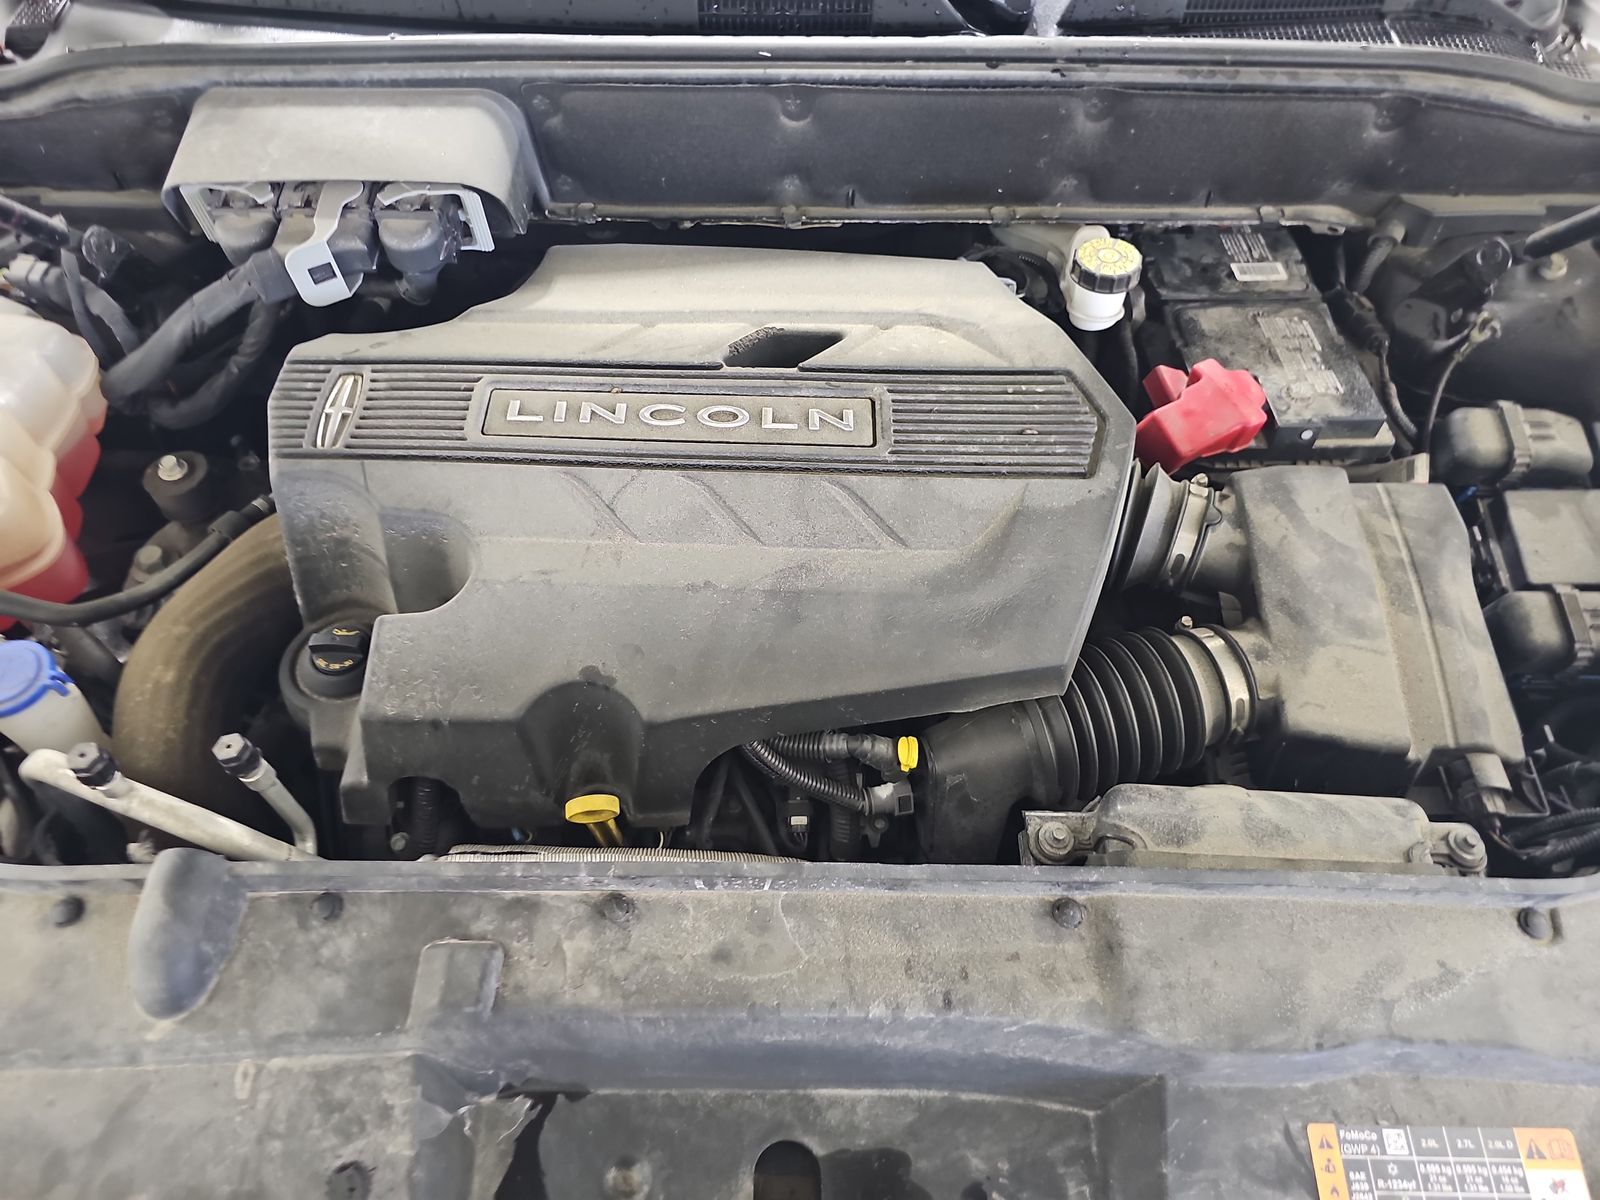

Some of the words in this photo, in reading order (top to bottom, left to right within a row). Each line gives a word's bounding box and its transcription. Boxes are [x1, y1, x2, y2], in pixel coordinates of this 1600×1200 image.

[506, 400, 854, 431] LINCOLN
[1340, 1129, 1377, 1140] FoMoCo
[1421, 1138, 1439, 1148] 2.0L
[1456, 1138, 1475, 1149] 2.7L
[1340, 1143, 1368, 1155] (GWP
[1370, 1143, 1380, 1157] 4)
